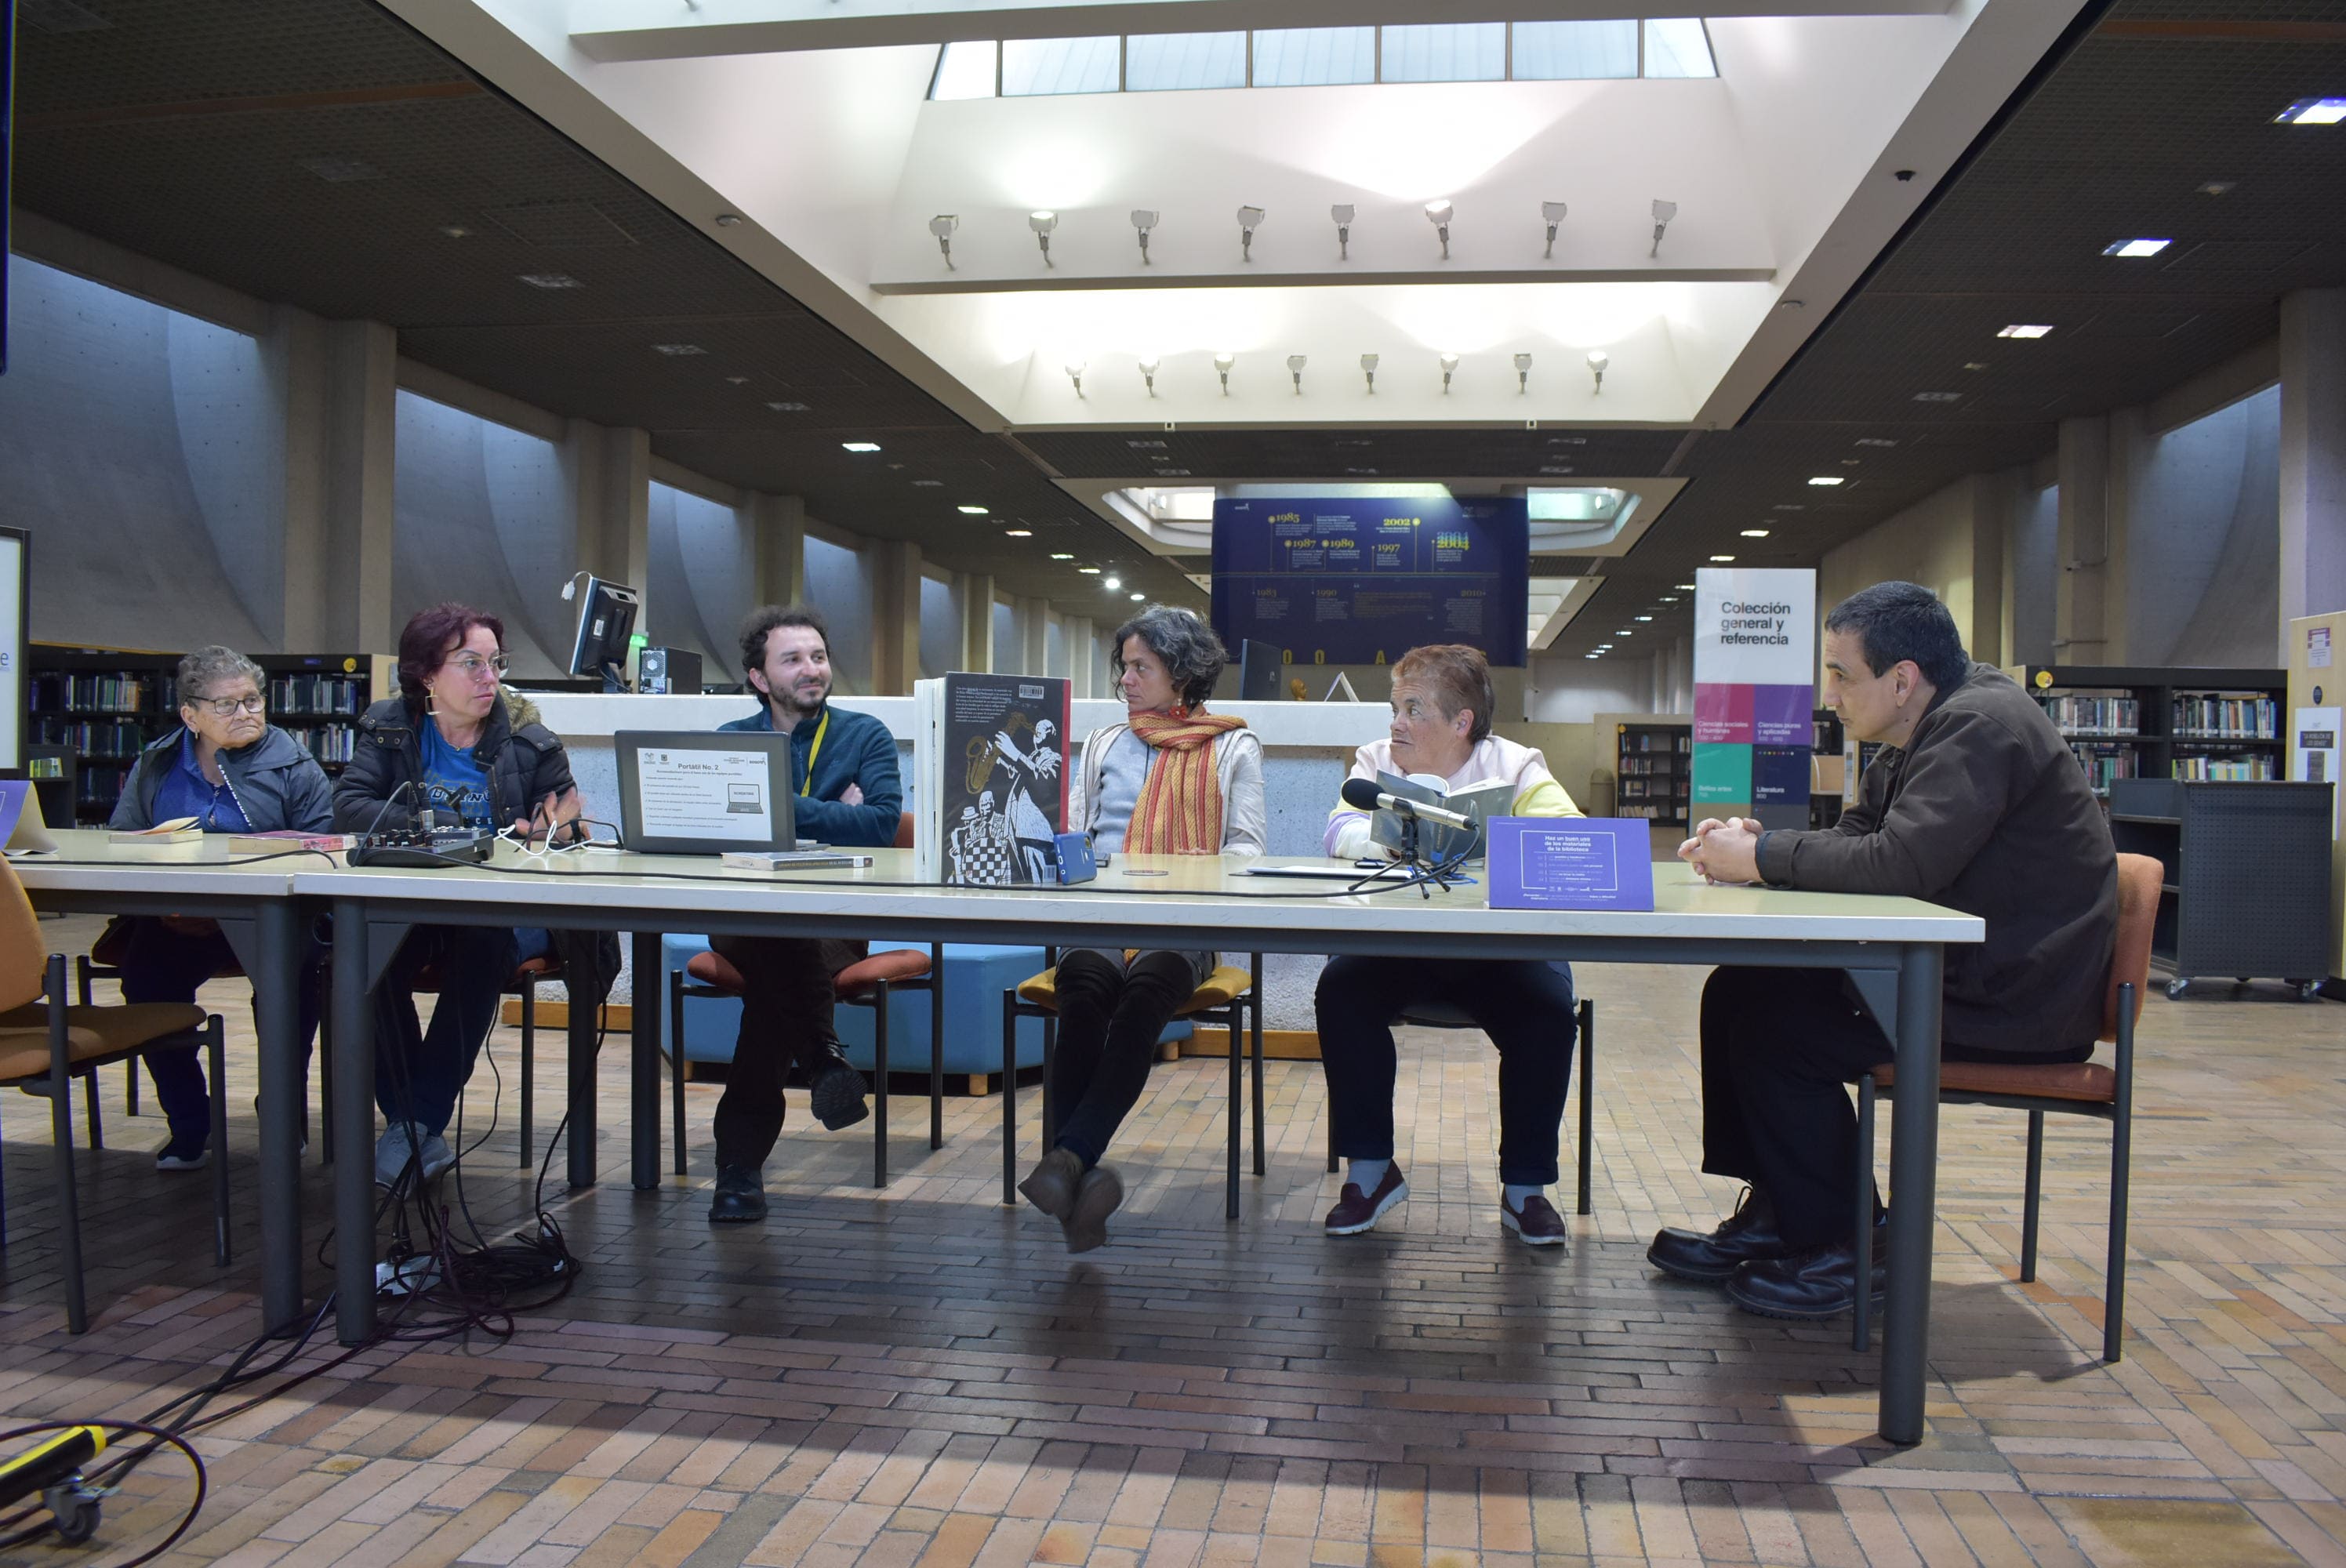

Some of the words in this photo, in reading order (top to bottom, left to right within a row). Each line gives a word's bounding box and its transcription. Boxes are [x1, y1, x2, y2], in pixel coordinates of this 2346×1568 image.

[1276, 512, 1300, 524] 1985
[1383, 517, 1411, 527] 2002
[1293, 538, 1316, 550] 1987
[1330, 538, 1354, 550] 1989
[1378, 543, 1400, 554] 1997
[1256, 588, 1276, 598] 1983
[1317, 588, 1337, 598] 1990
[1461, 589, 1483, 597] 2010
[1721, 601, 1791, 614] Colección
[1721, 617, 1772, 631] general
[1776, 619, 1785, 632] y
[1721, 632, 1789, 644] referencia
